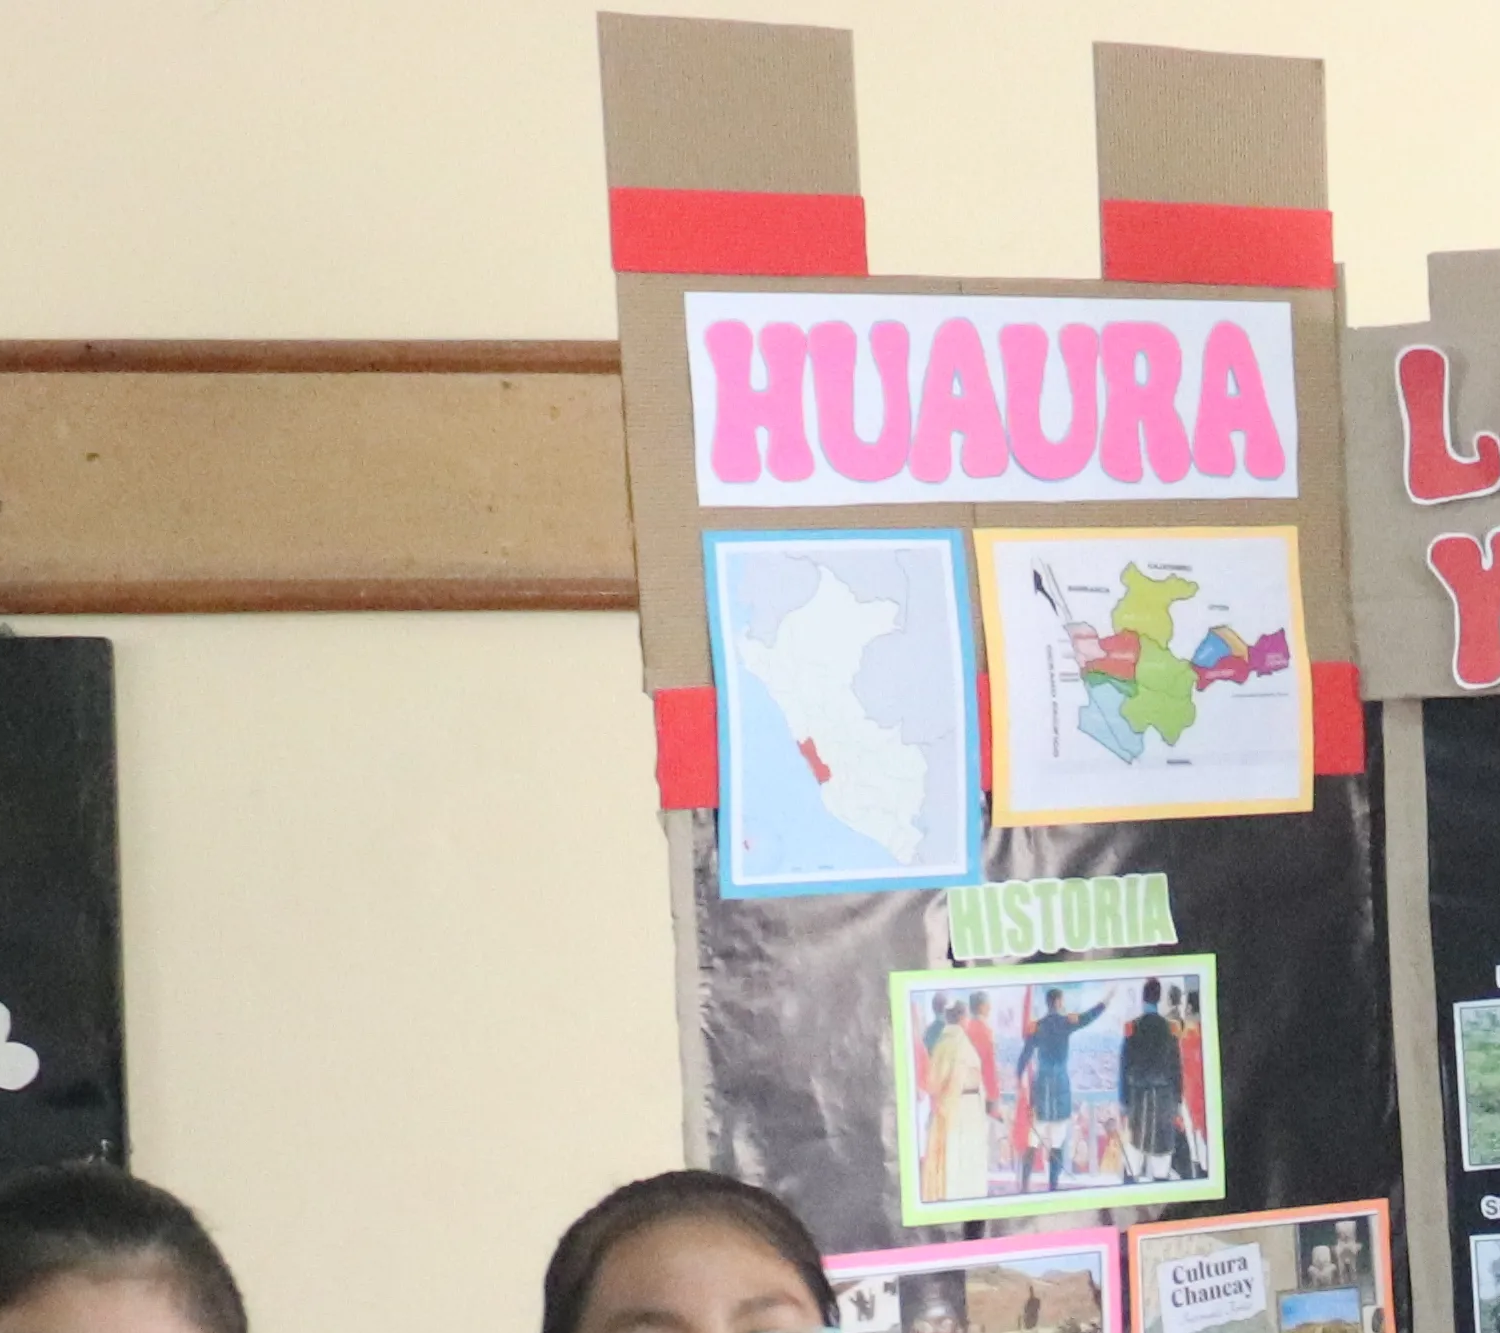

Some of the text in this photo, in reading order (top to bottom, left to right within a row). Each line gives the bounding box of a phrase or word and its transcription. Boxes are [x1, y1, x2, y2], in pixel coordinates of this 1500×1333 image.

[703, 317, 1287, 483] HUAURA
[951, 876, 1176, 958] HISTORIA
[1171, 1277, 1254, 1308] Chancay
[1172, 1256, 1248, 1285] Cultura
